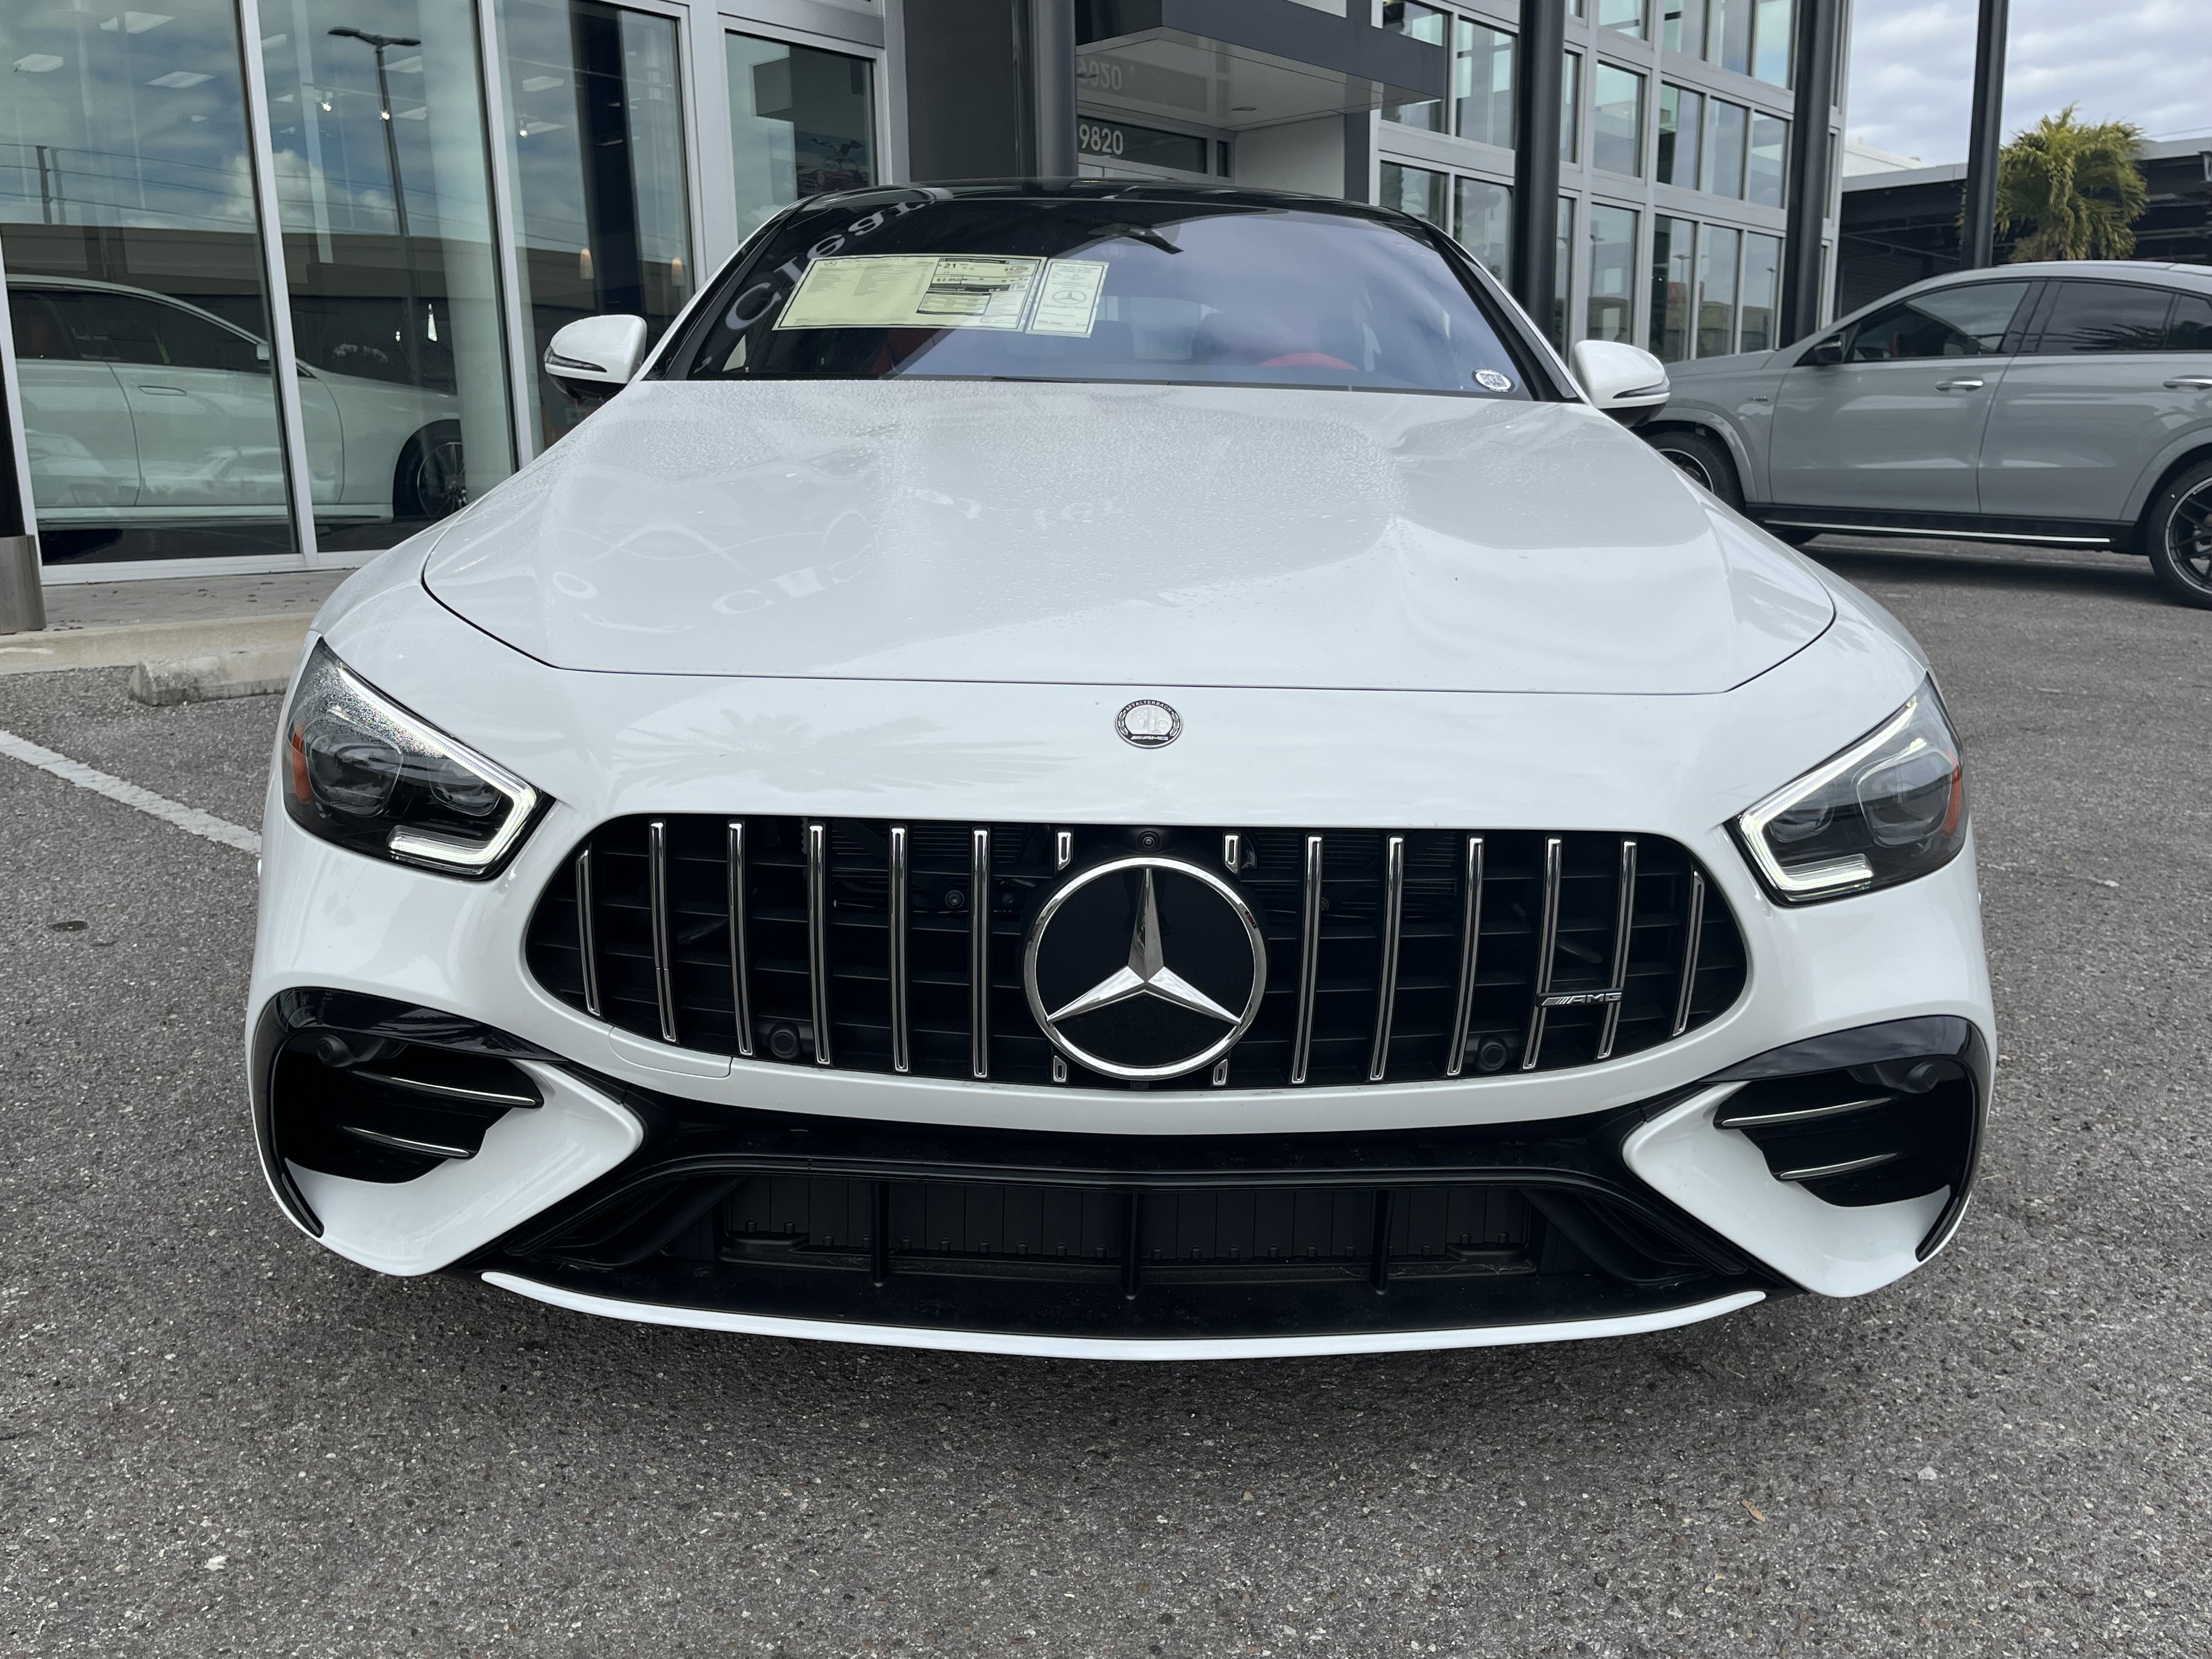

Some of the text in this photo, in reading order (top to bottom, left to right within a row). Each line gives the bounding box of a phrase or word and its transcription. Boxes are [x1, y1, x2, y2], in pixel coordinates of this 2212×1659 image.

[1079, 124, 1124, 155] 9820
[1125, 700, 1172, 712] AFFALTERBACH
[1566, 992, 1622, 1005] AMG
